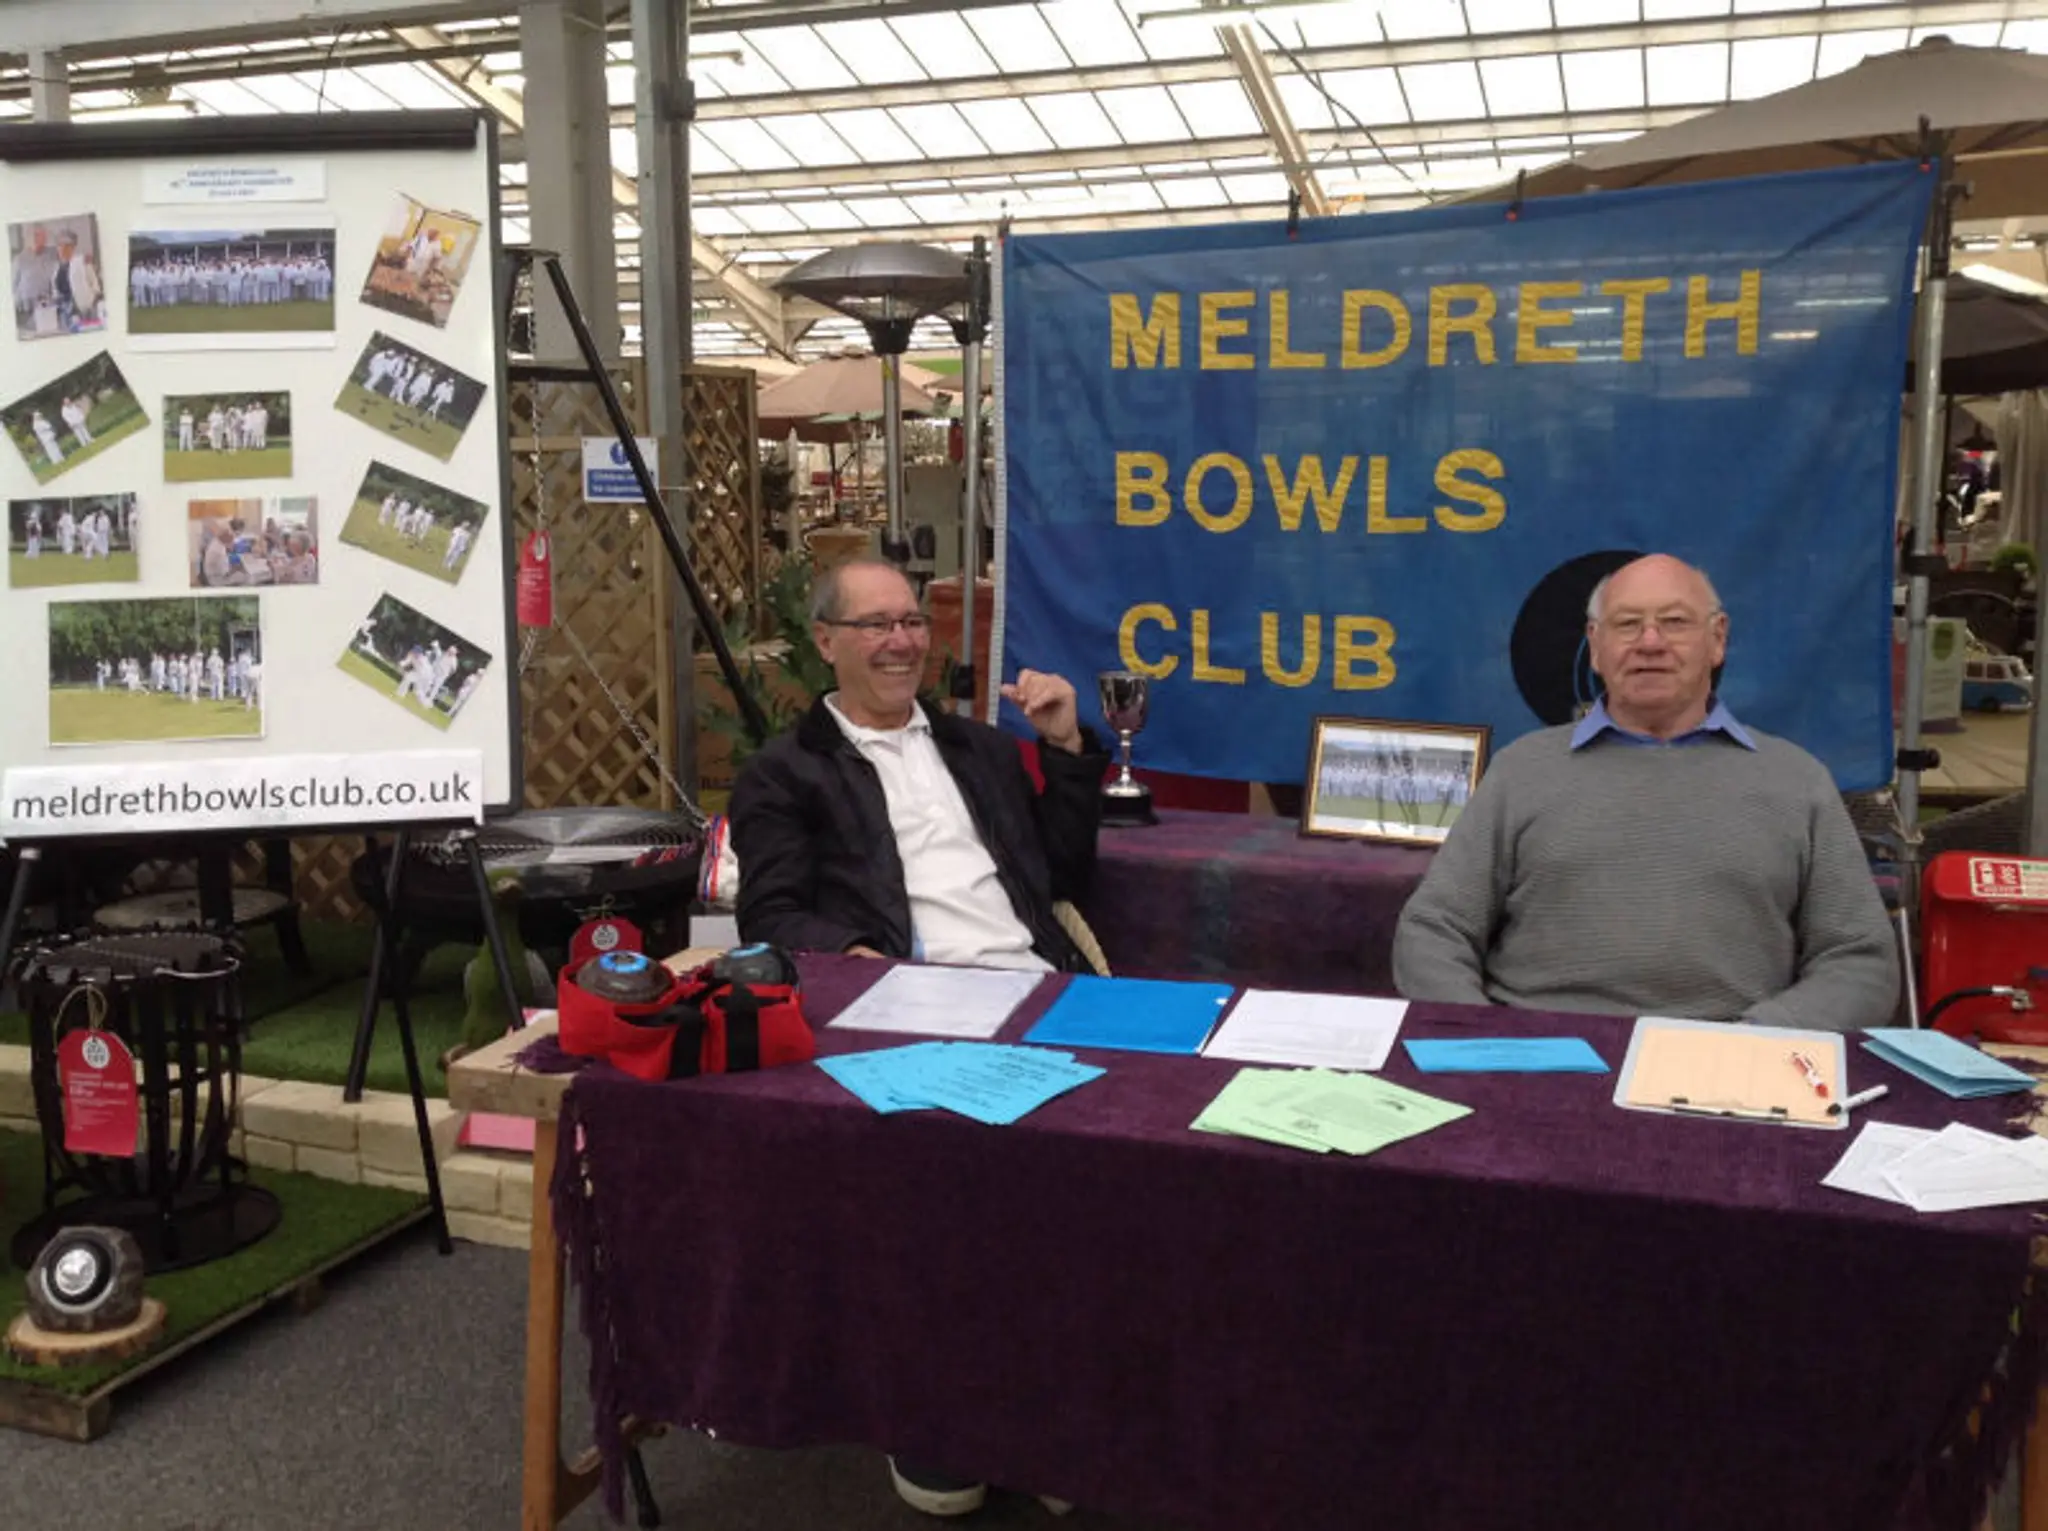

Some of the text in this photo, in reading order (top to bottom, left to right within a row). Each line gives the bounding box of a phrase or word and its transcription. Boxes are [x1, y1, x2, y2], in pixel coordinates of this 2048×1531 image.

[1109, 269, 1762, 370] MELDRETH
[1114, 449, 1506, 534] BOWLS
[1118, 603, 1397, 690] CLUB
[12, 773, 470, 818] meldrethbowlsclub.co.uk
